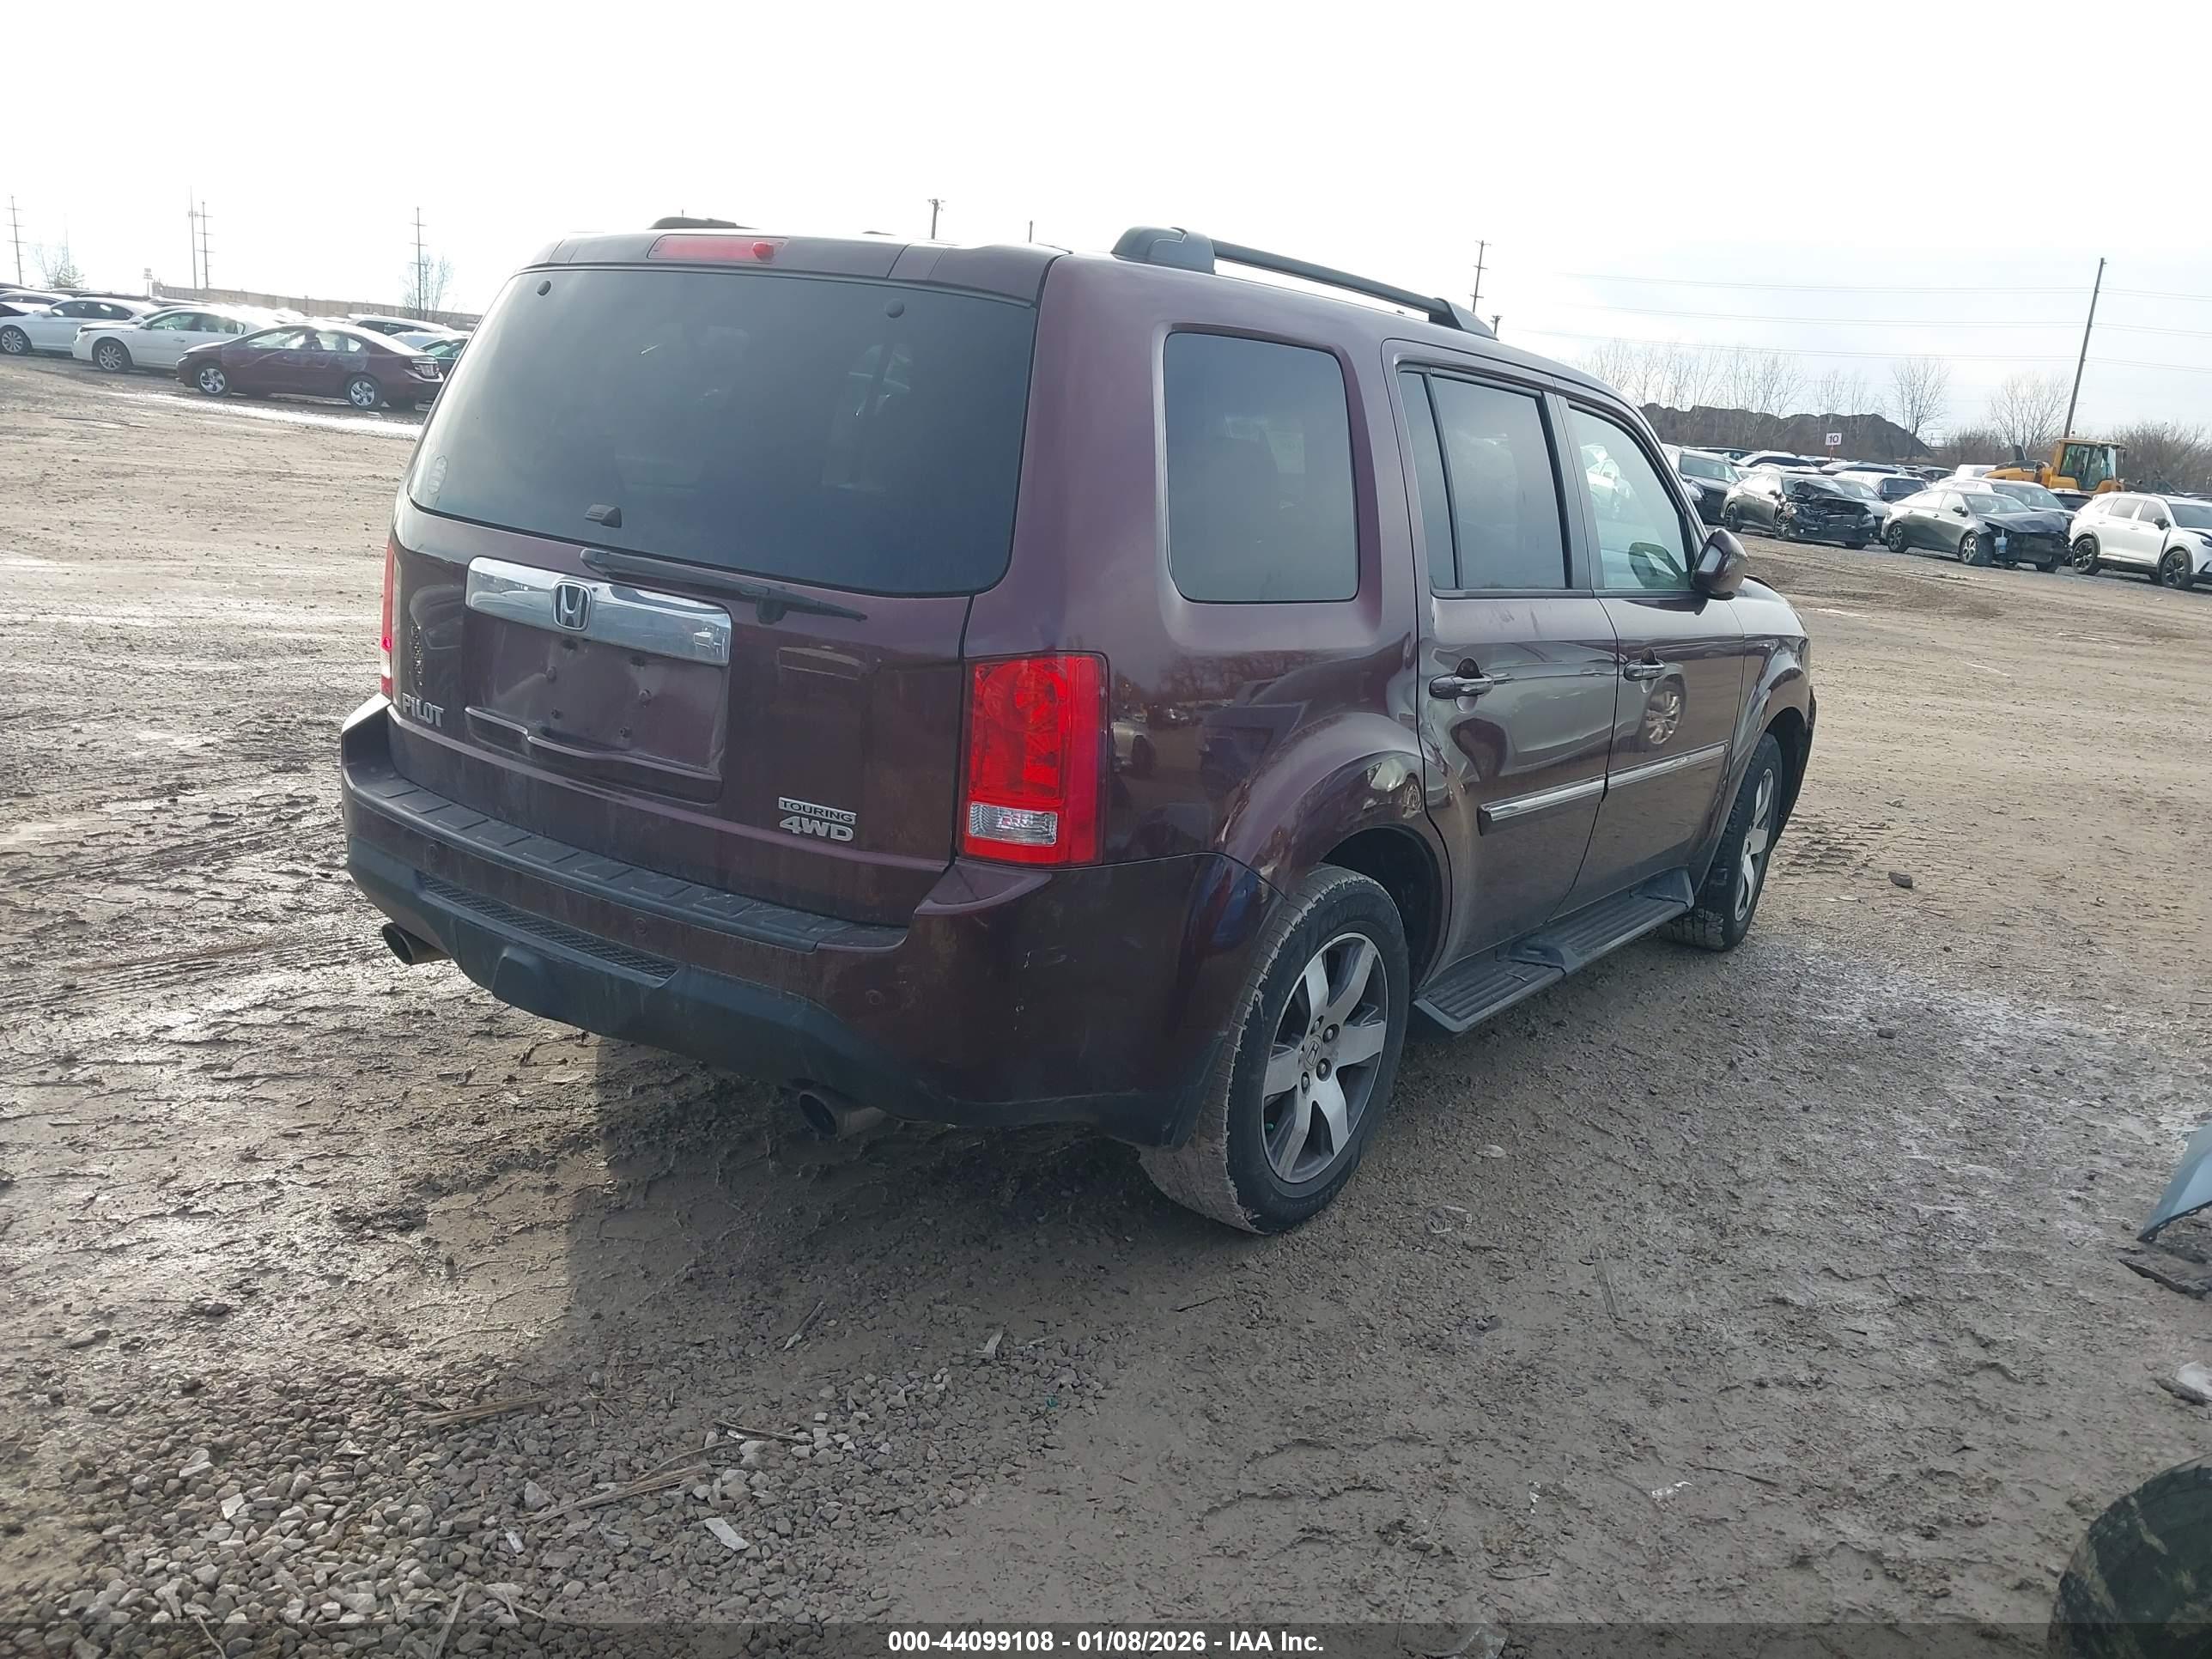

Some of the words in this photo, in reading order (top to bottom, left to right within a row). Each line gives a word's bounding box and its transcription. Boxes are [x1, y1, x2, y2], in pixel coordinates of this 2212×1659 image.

[1828, 434, 1839, 443] 10
[402, 692, 445, 728] PILOT
[781, 799, 854, 823] TOURING
[779, 816, 854, 842] 4WD
